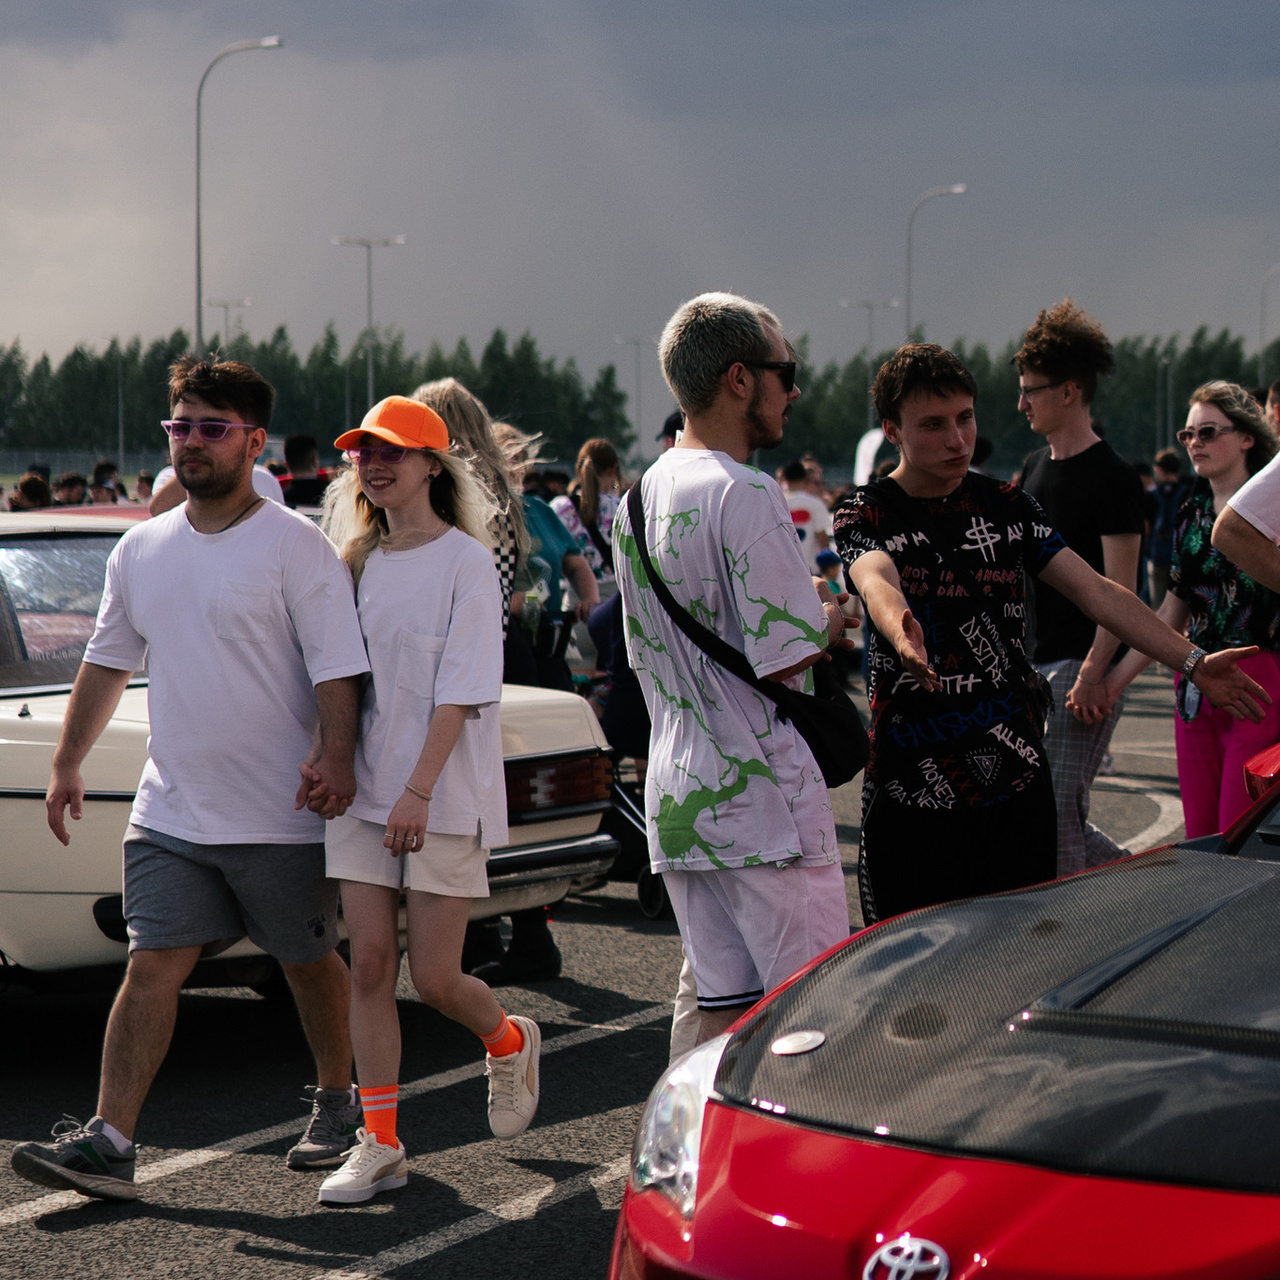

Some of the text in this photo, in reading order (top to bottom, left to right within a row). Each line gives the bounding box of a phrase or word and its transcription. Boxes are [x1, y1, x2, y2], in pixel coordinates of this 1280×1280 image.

[902, 565, 930, 580] NOT
[970, 568, 1018, 584] ANGER,
[918, 757, 956, 810] MONEY
